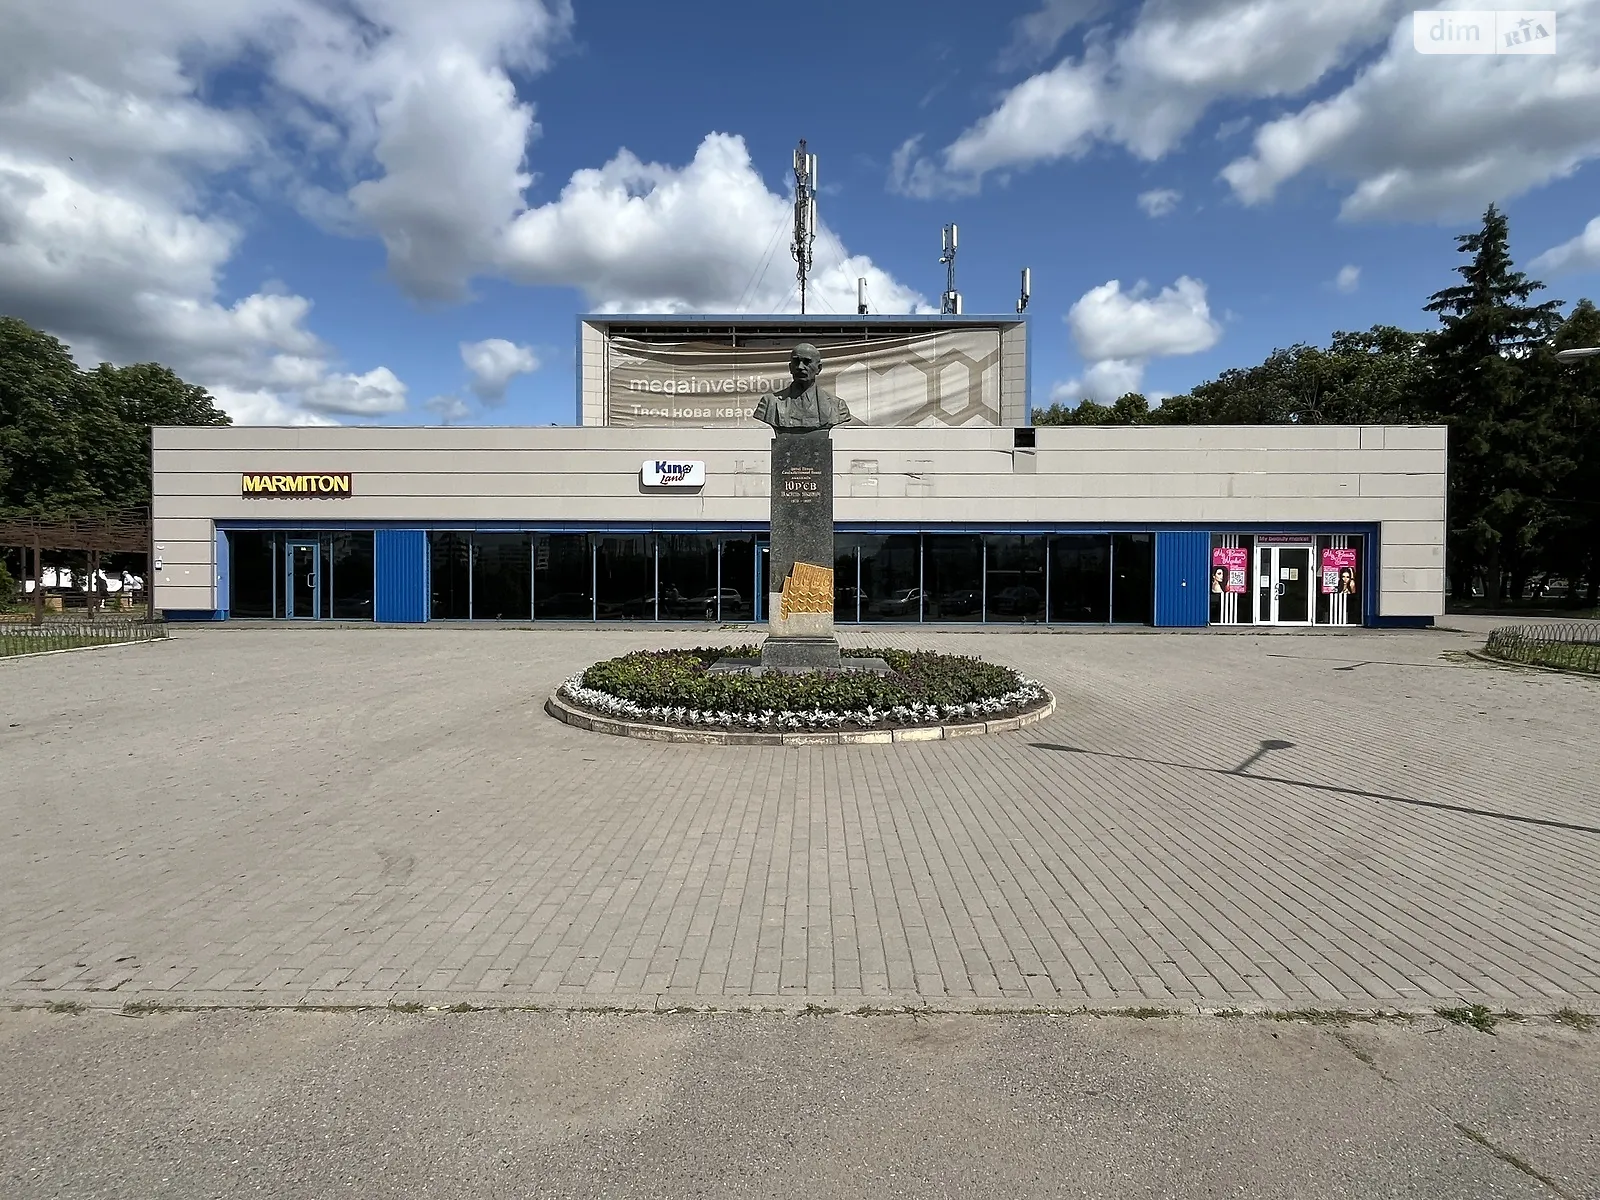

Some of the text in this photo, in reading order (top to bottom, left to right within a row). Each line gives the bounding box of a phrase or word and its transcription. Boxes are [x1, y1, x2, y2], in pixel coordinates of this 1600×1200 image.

[631, 404, 669, 418] Твоя
[673, 407, 712, 419] нова
[243, 475, 349, 492] MARMITON
[660, 472, 687, 485] Land
